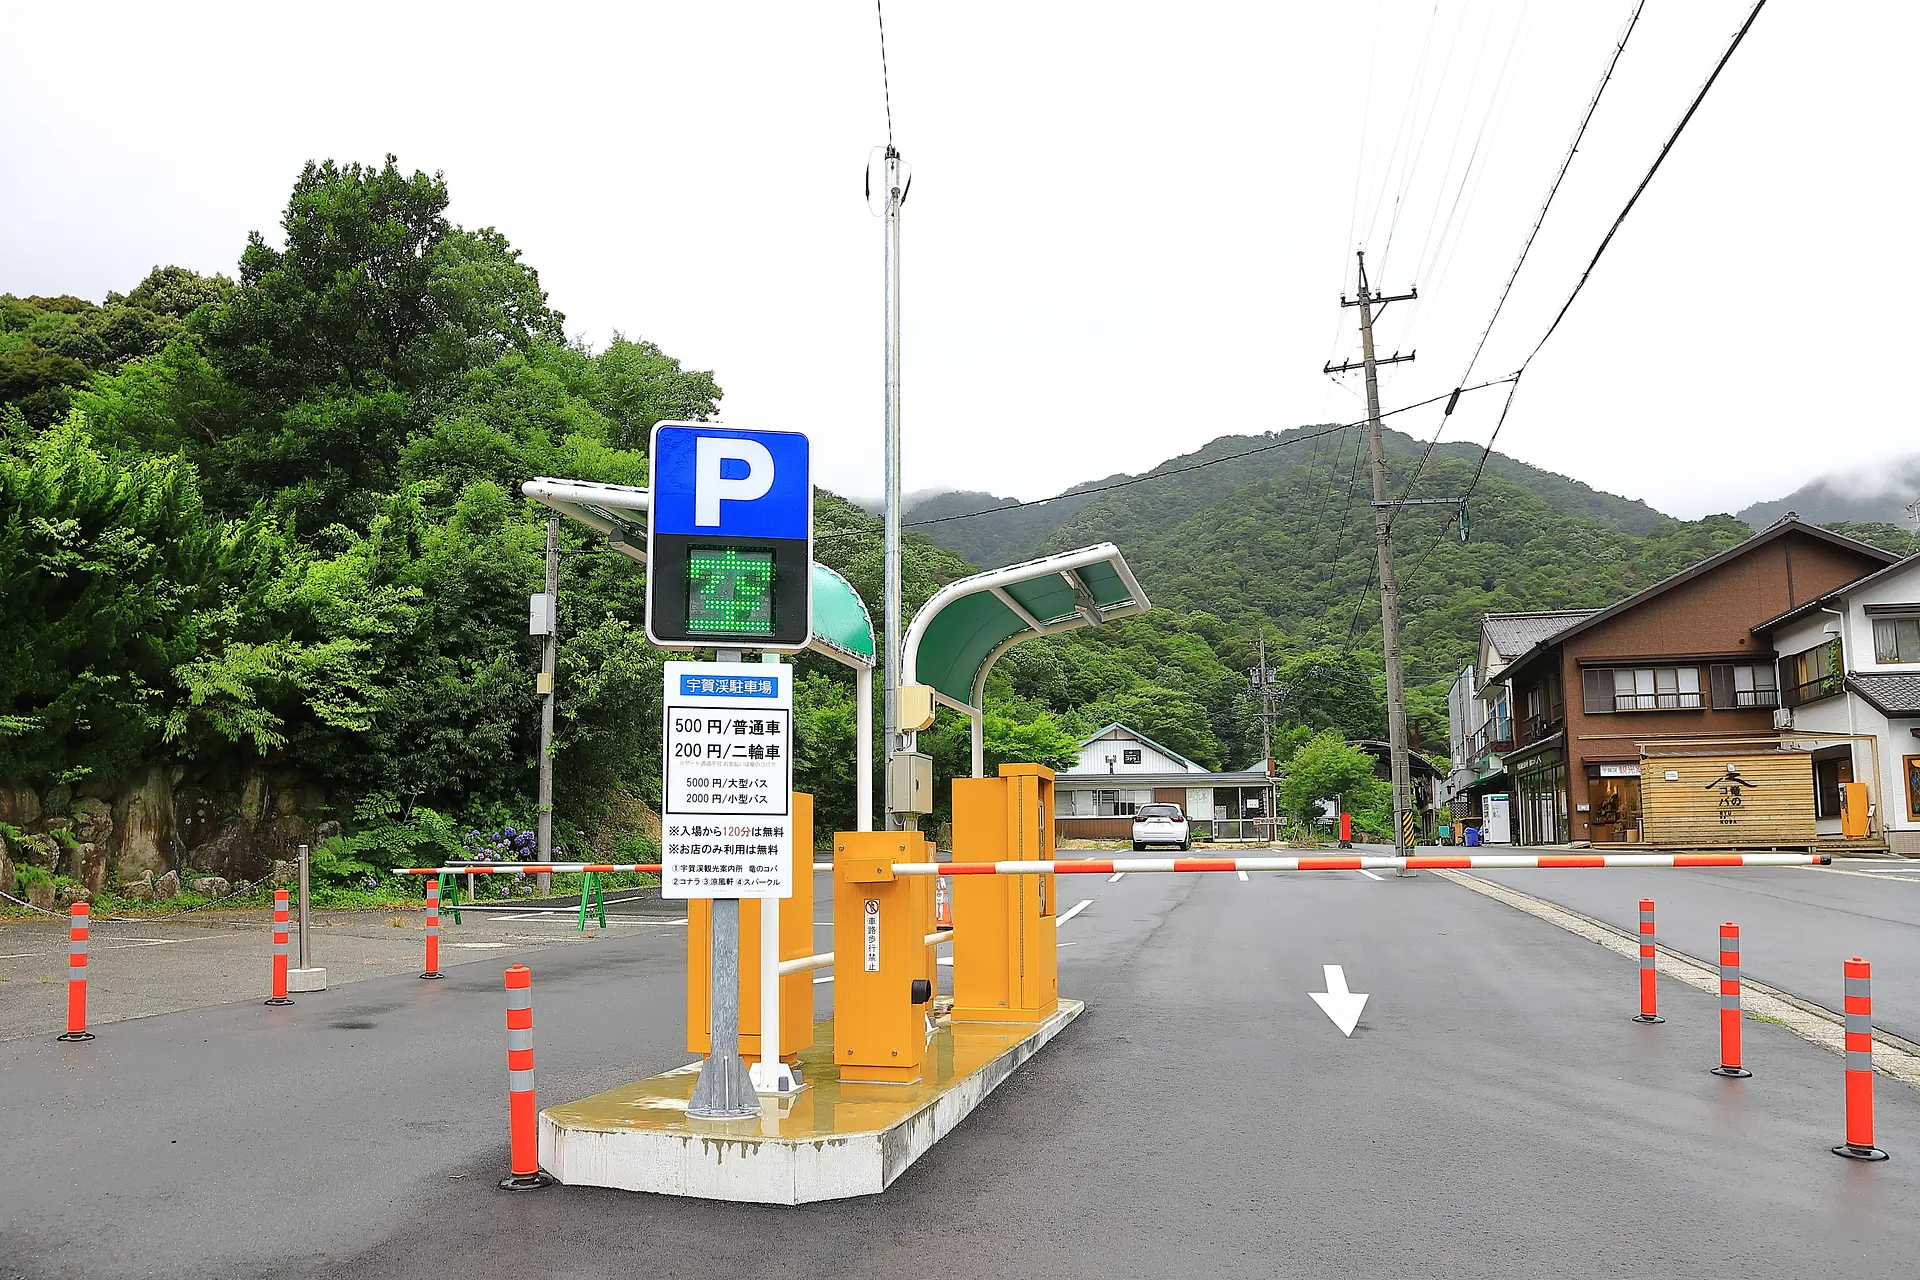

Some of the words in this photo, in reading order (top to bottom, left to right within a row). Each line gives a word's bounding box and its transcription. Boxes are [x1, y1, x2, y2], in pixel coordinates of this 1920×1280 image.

[695, 437, 775, 527] P
[686, 678, 773, 695] 宇賀渓駐車場
[675, 718, 703, 733] 500
[707, 718, 781, 736] 円/普通車
[675, 743, 702, 758] 200
[707, 743, 781, 760] 円/二輪車
[686, 778, 710, 788] 5000
[686, 794, 709, 803] 2000
